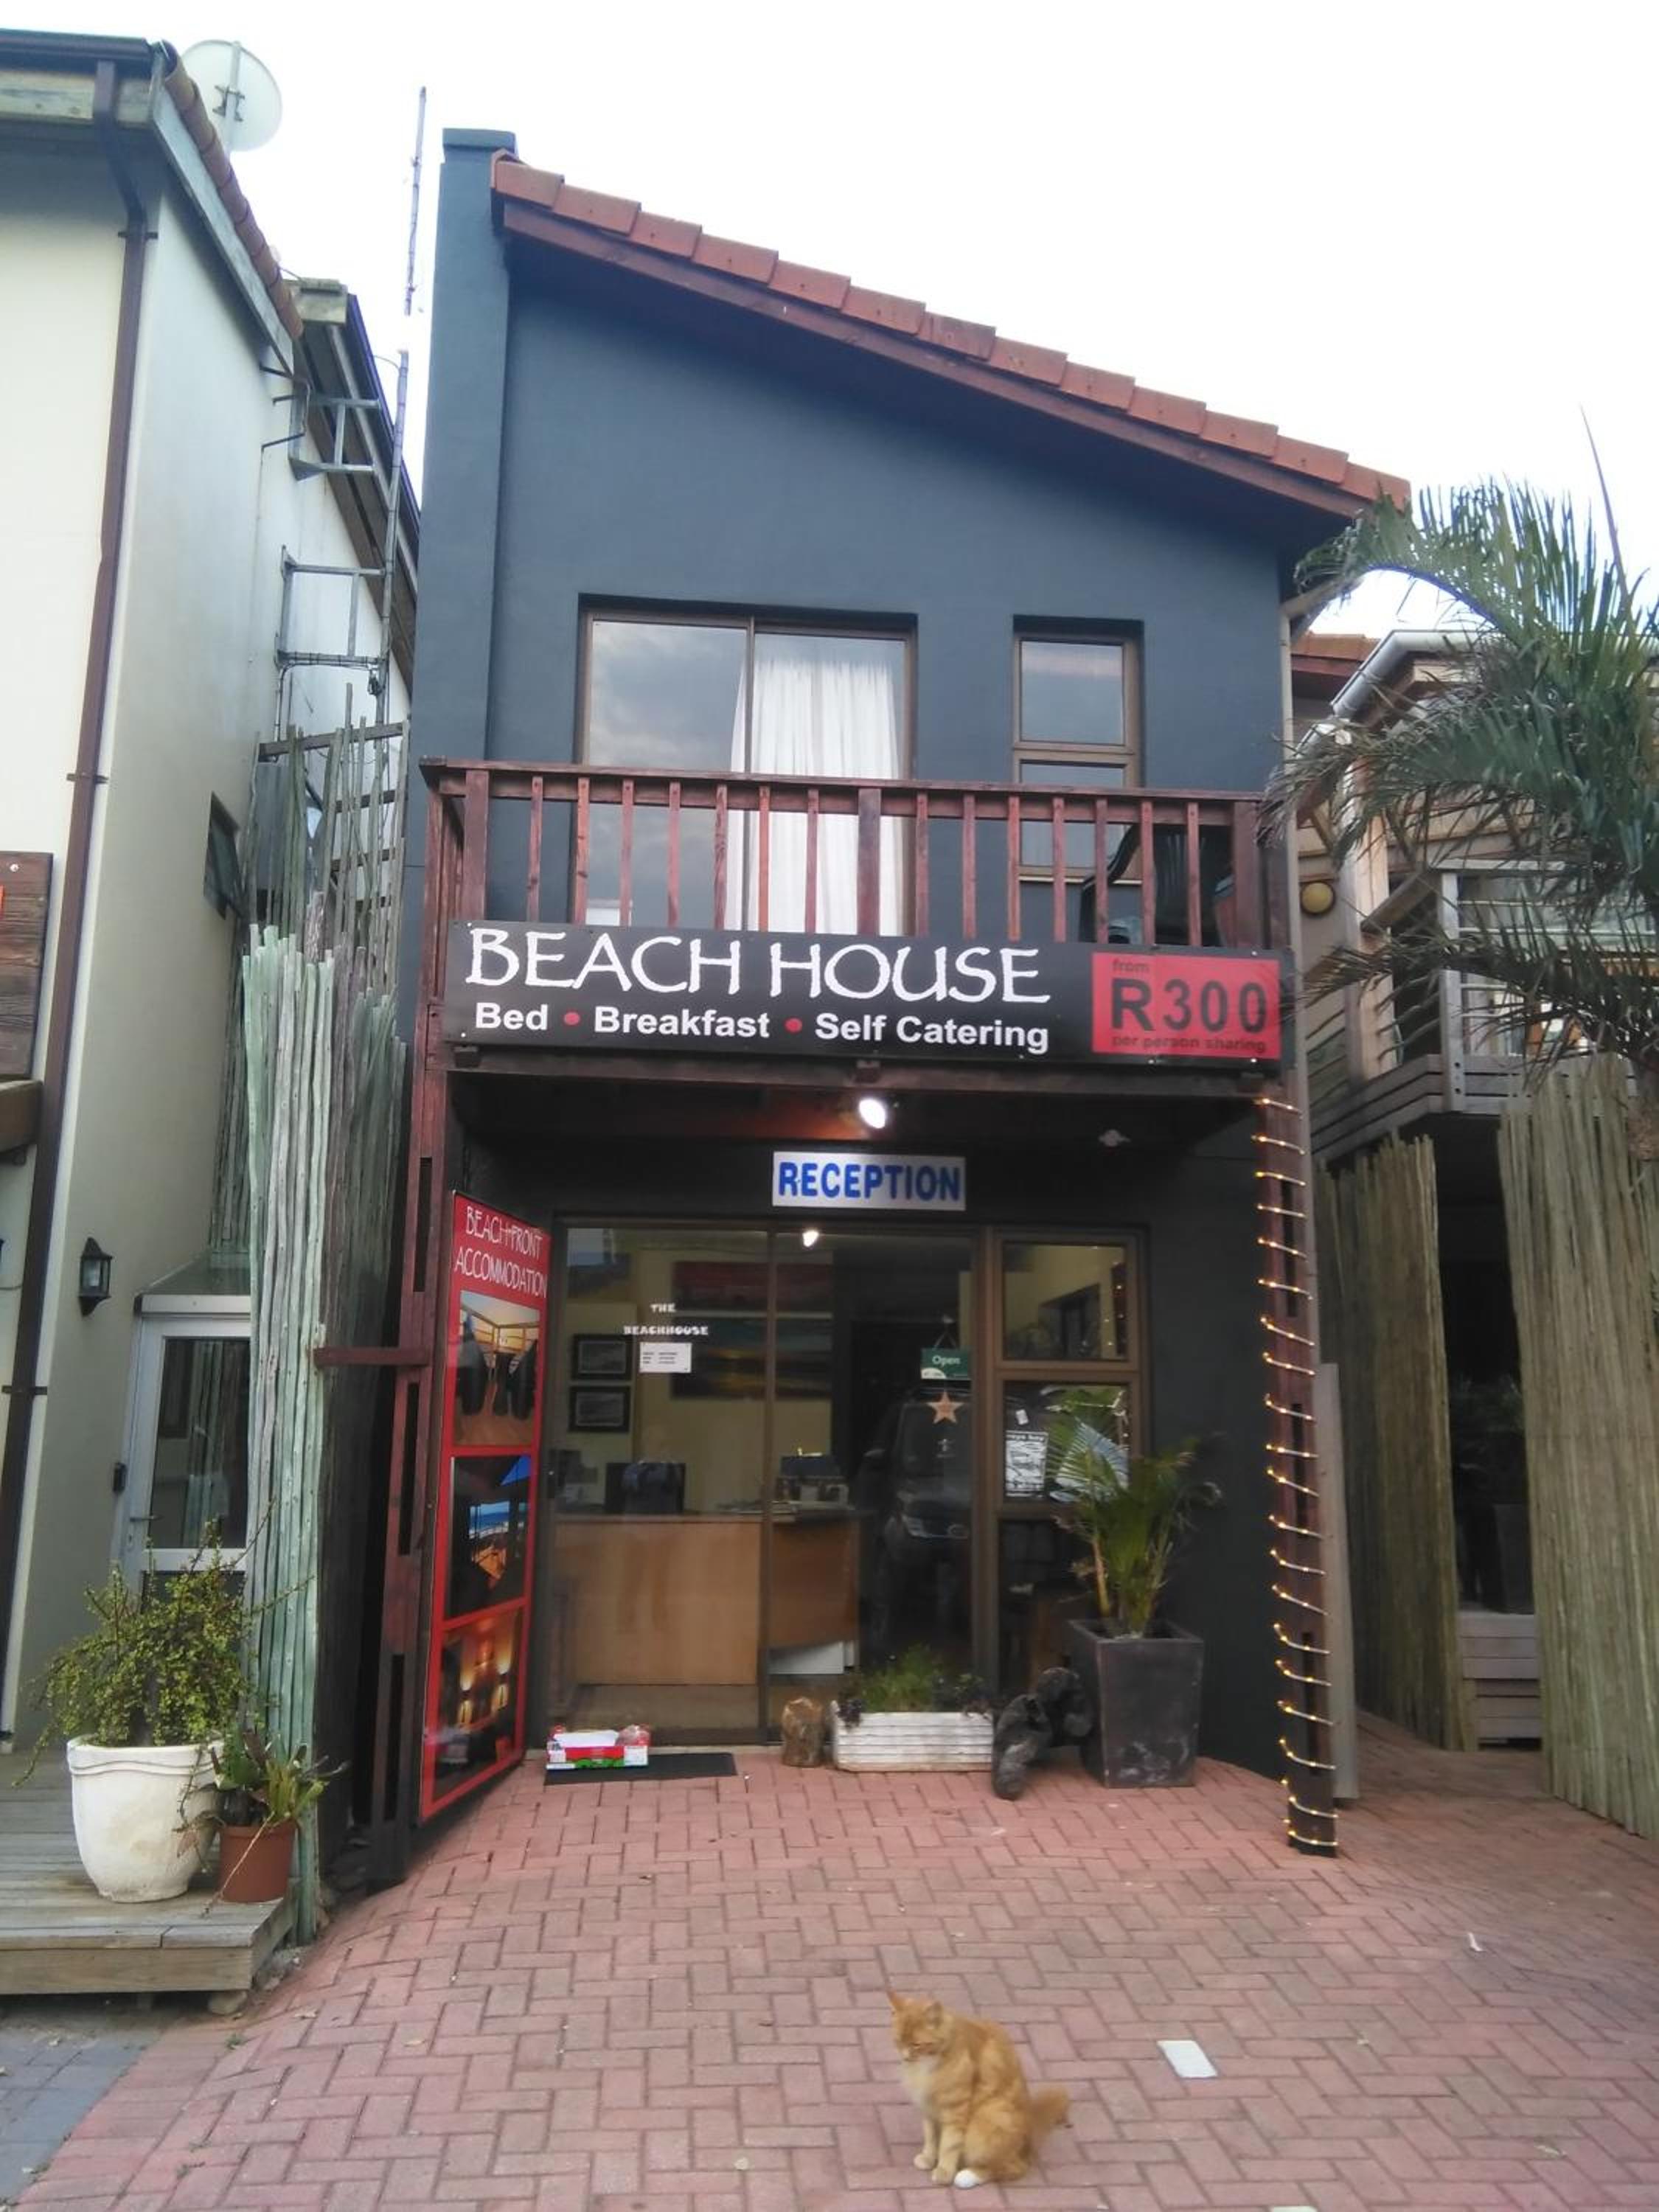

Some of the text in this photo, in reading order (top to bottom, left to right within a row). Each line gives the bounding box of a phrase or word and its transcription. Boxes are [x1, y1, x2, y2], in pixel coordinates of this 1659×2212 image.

[465, 928, 1051, 1004] BEACH HOUSE
[1113, 959, 1150, 973] from
[475, 1001, 1049, 1056] Bed Breakfast Self Catering
[1112, 1036, 1266, 1053] per person sharing
[778, 1161, 959, 1201] RECEPTION
[650, 1303, 676, 1312] THE
[932, 1354, 961, 1368] Open
